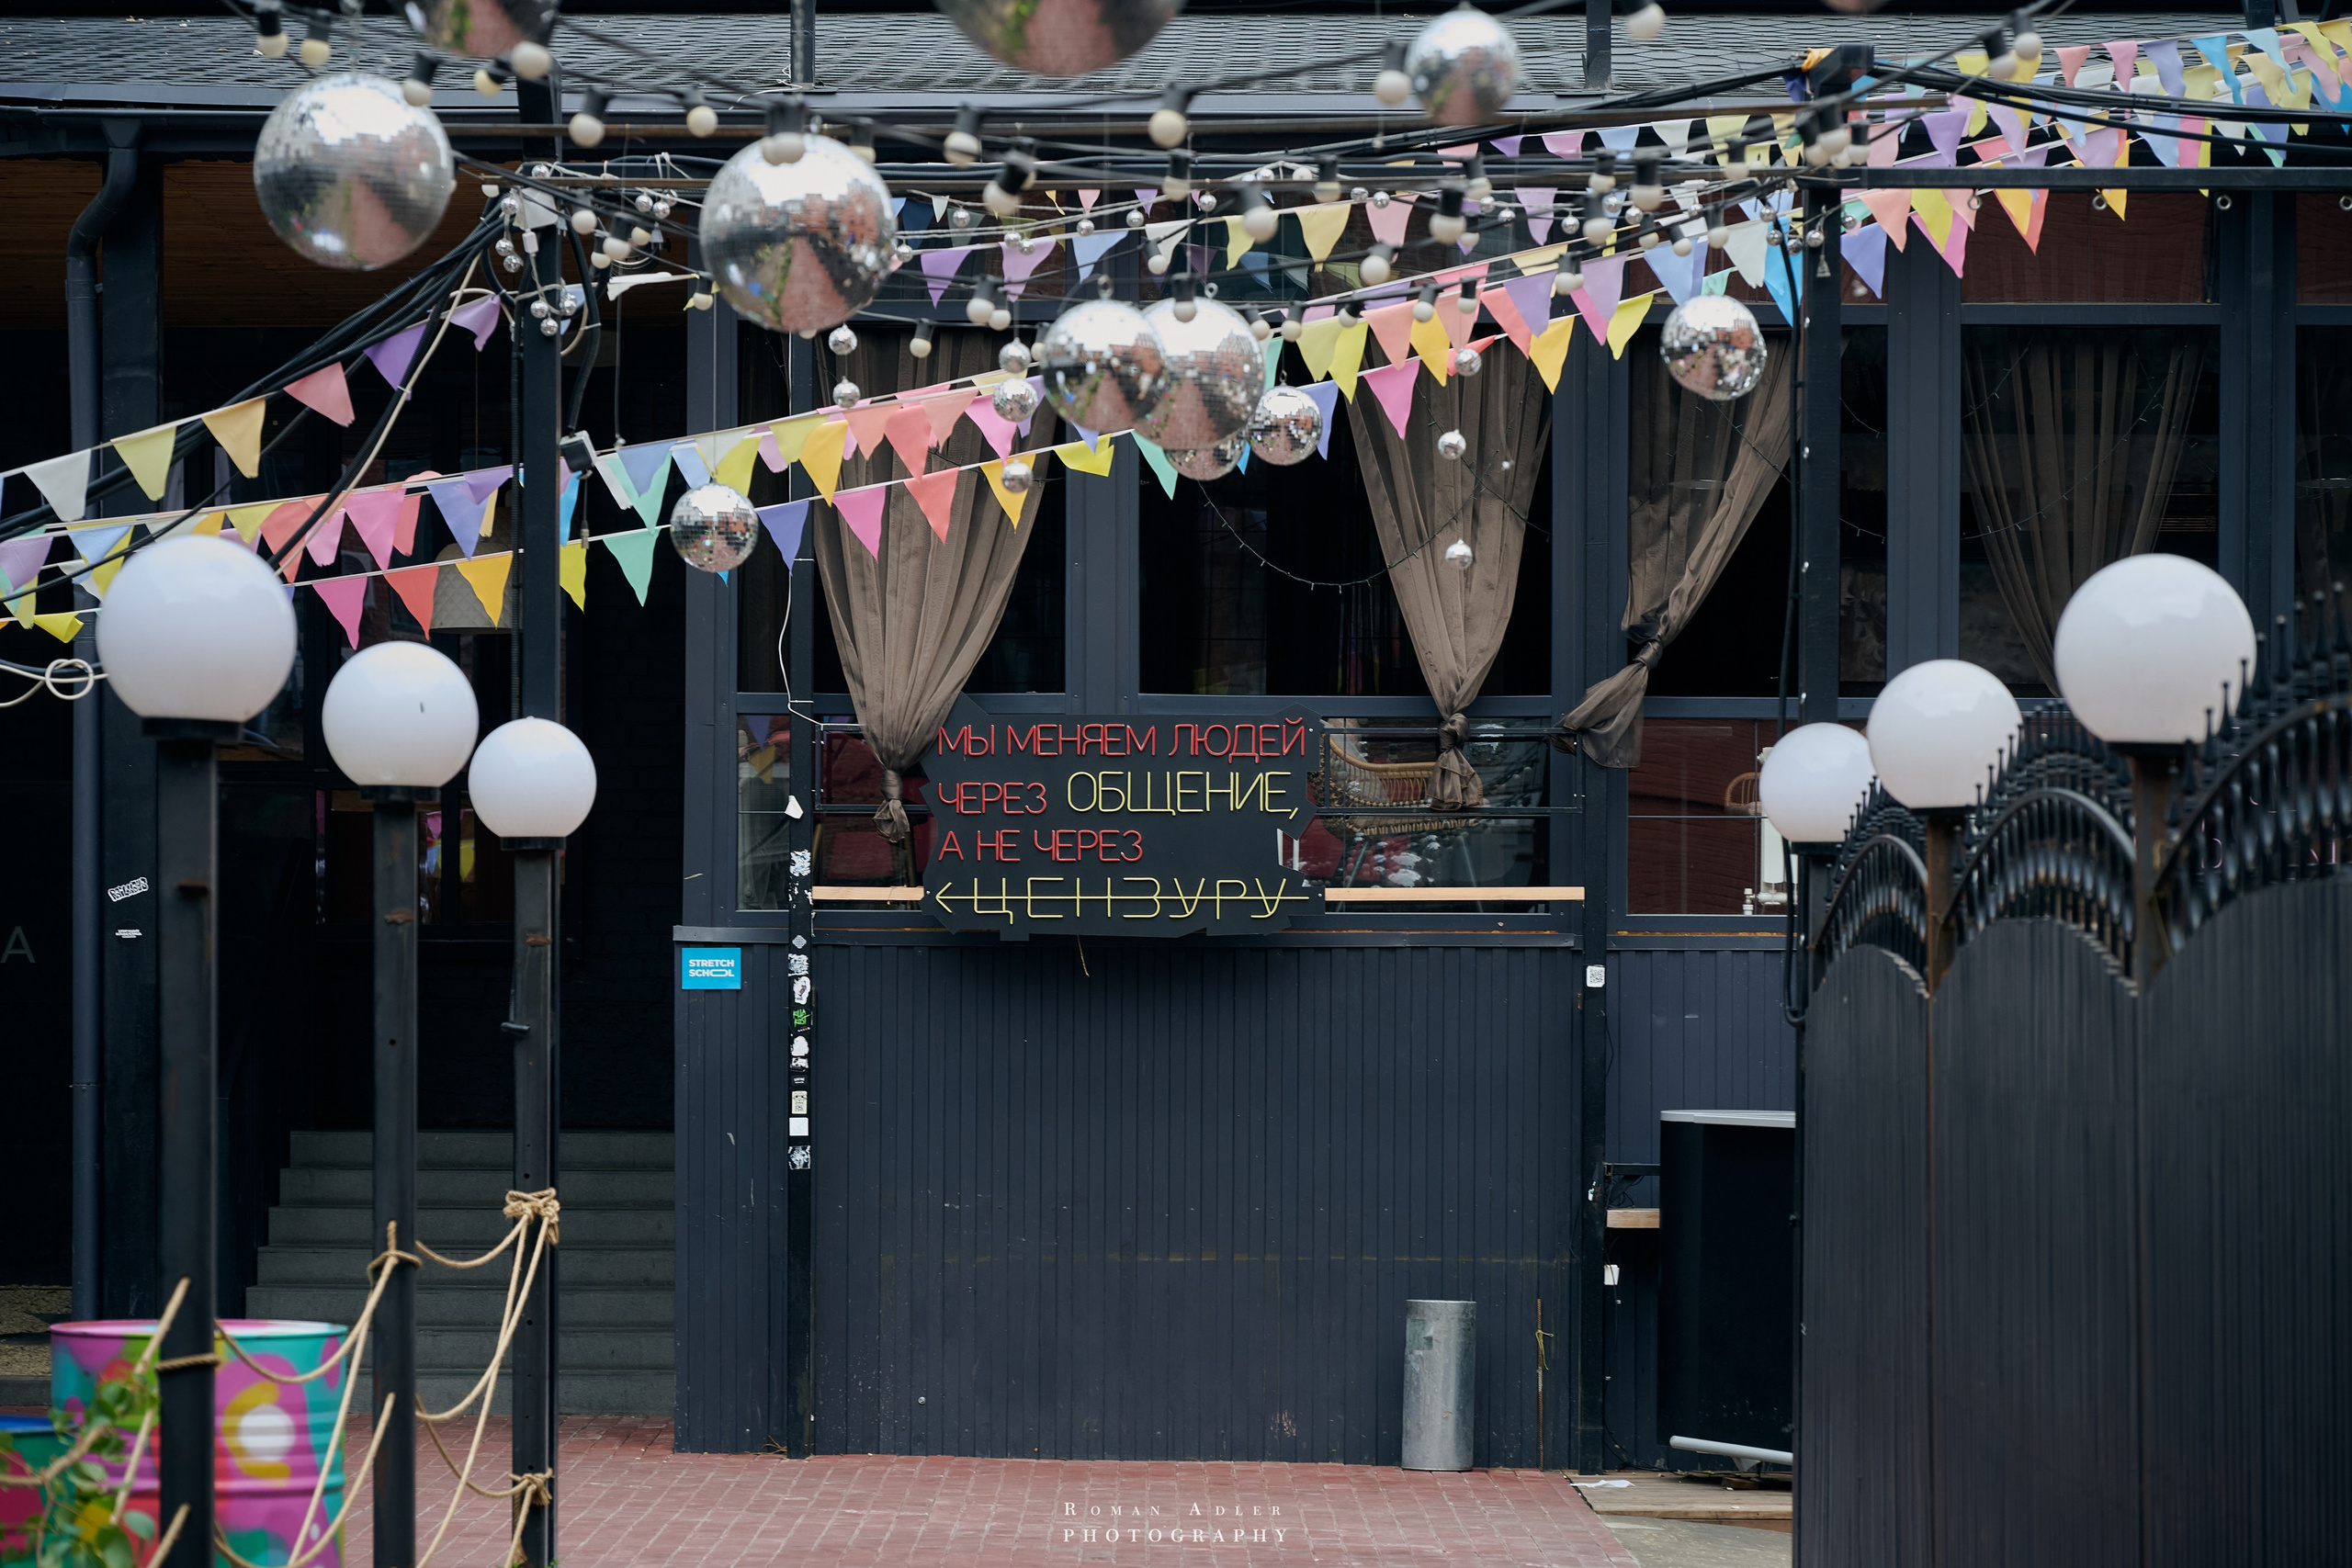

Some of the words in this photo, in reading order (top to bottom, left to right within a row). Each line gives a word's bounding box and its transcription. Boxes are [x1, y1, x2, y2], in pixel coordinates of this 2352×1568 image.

[937, 724, 995, 757] МЫ
[1007, 724, 1156, 757] МЕНЯЕМ
[1169, 716, 1306, 763] ЛЮДЕЙ
[938, 782, 1047, 815] ЧЕРЕЗ
[1067, 771, 1299, 819] ОБЩЕНИЕ,
[938, 830, 964, 861] А
[977, 829, 1021, 862] НЕ
[1033, 829, 1143, 862] ЧЕРЕЗ
[973, 877, 1287, 925] ЦЕНЗУРУ
[689, 959, 735, 967] STRETCH
